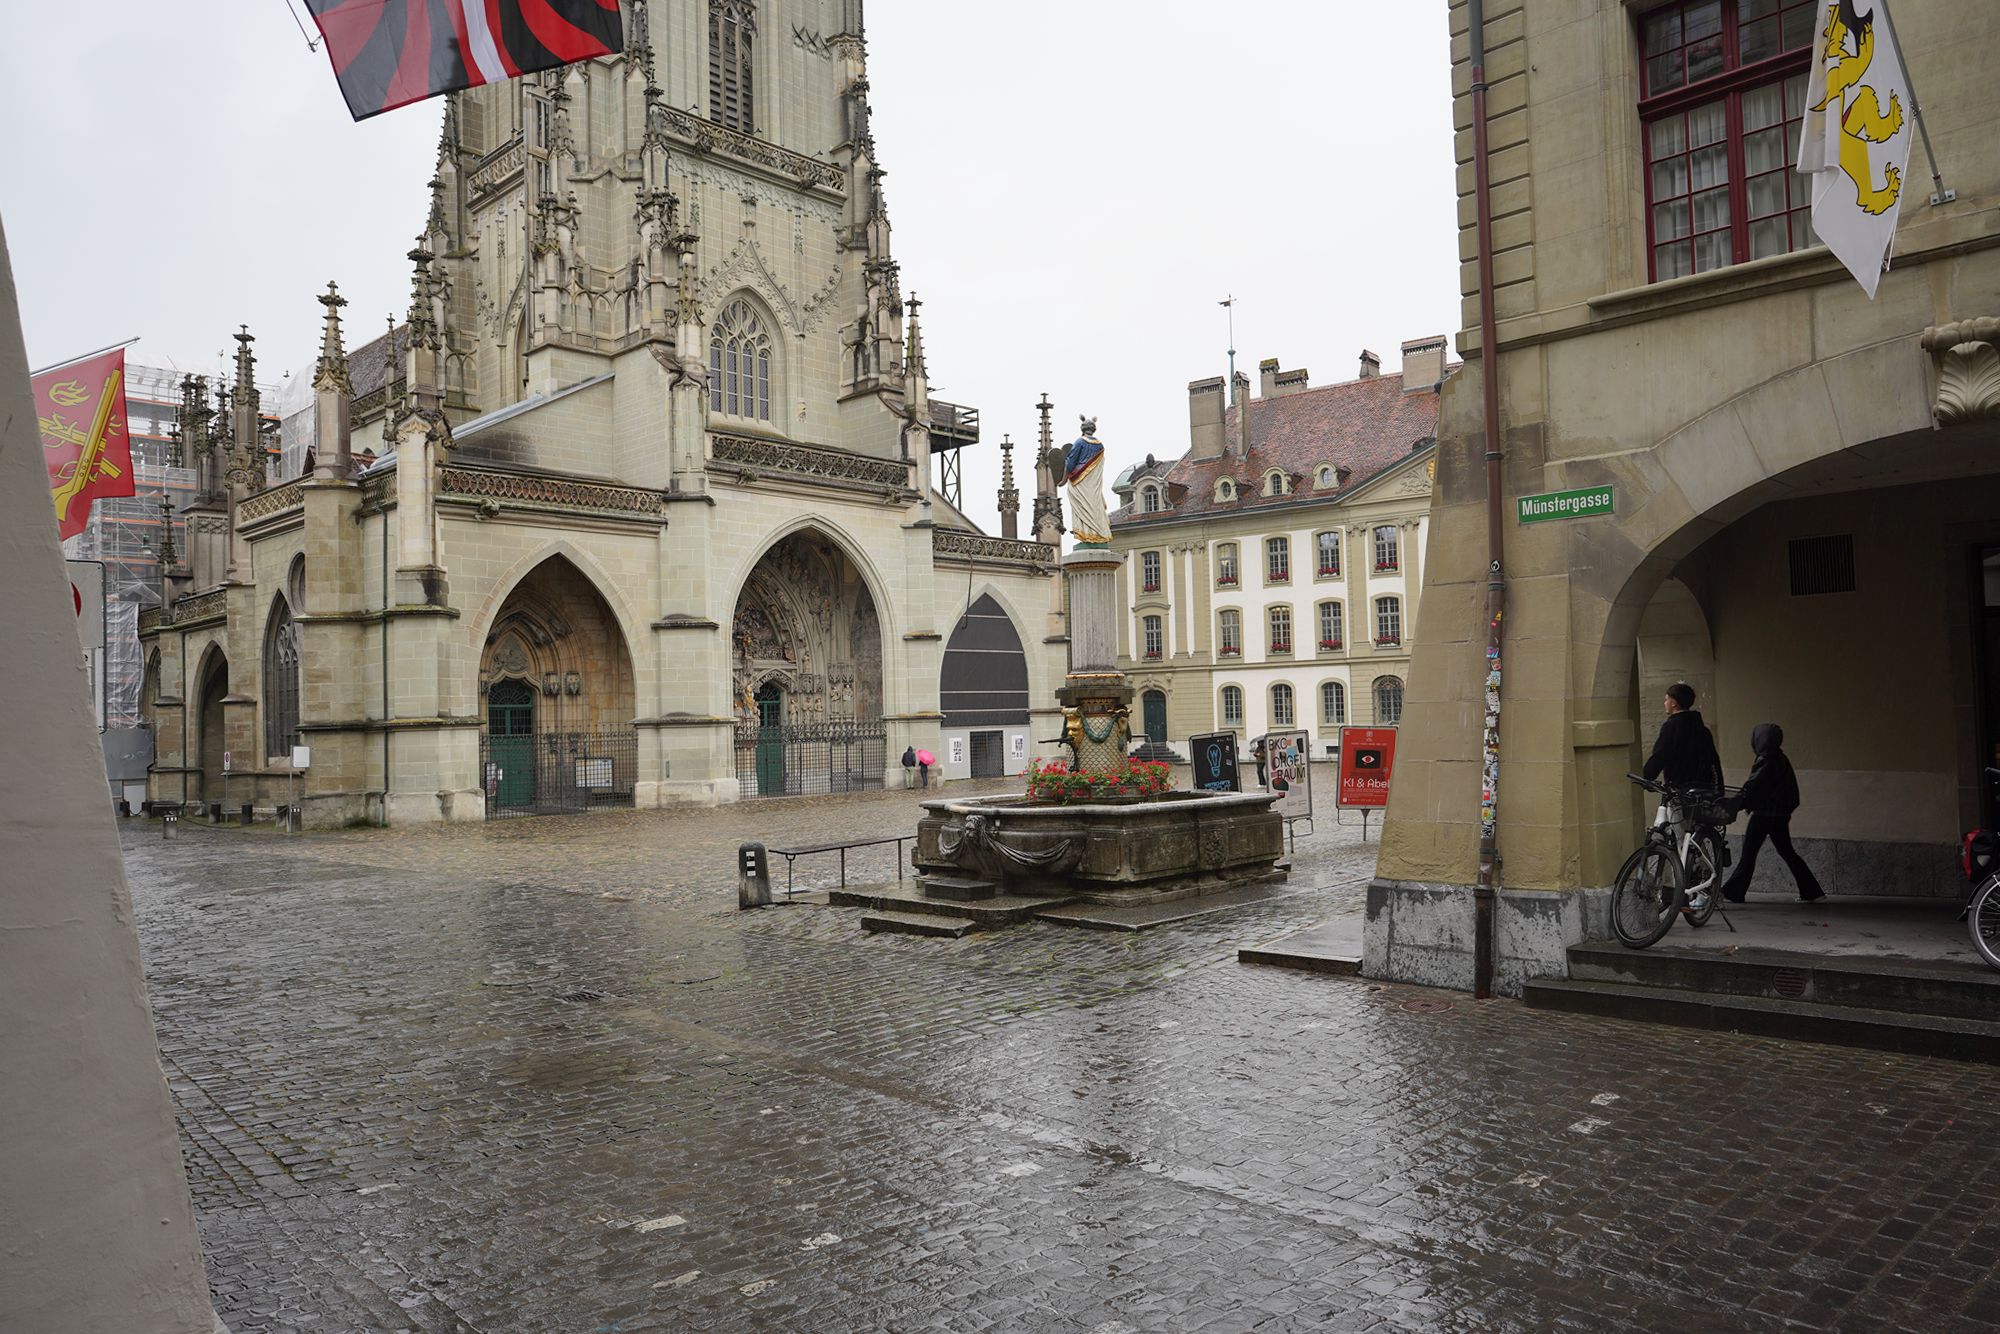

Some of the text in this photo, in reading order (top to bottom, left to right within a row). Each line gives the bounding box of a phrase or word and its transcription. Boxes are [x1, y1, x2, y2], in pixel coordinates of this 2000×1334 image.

[1522, 493, 1609, 516] Münstergasse
[1272, 749, 1305, 768] ORGEL
[1343, 778, 1354, 787] KI
[1356, 777, 1365, 788] &
